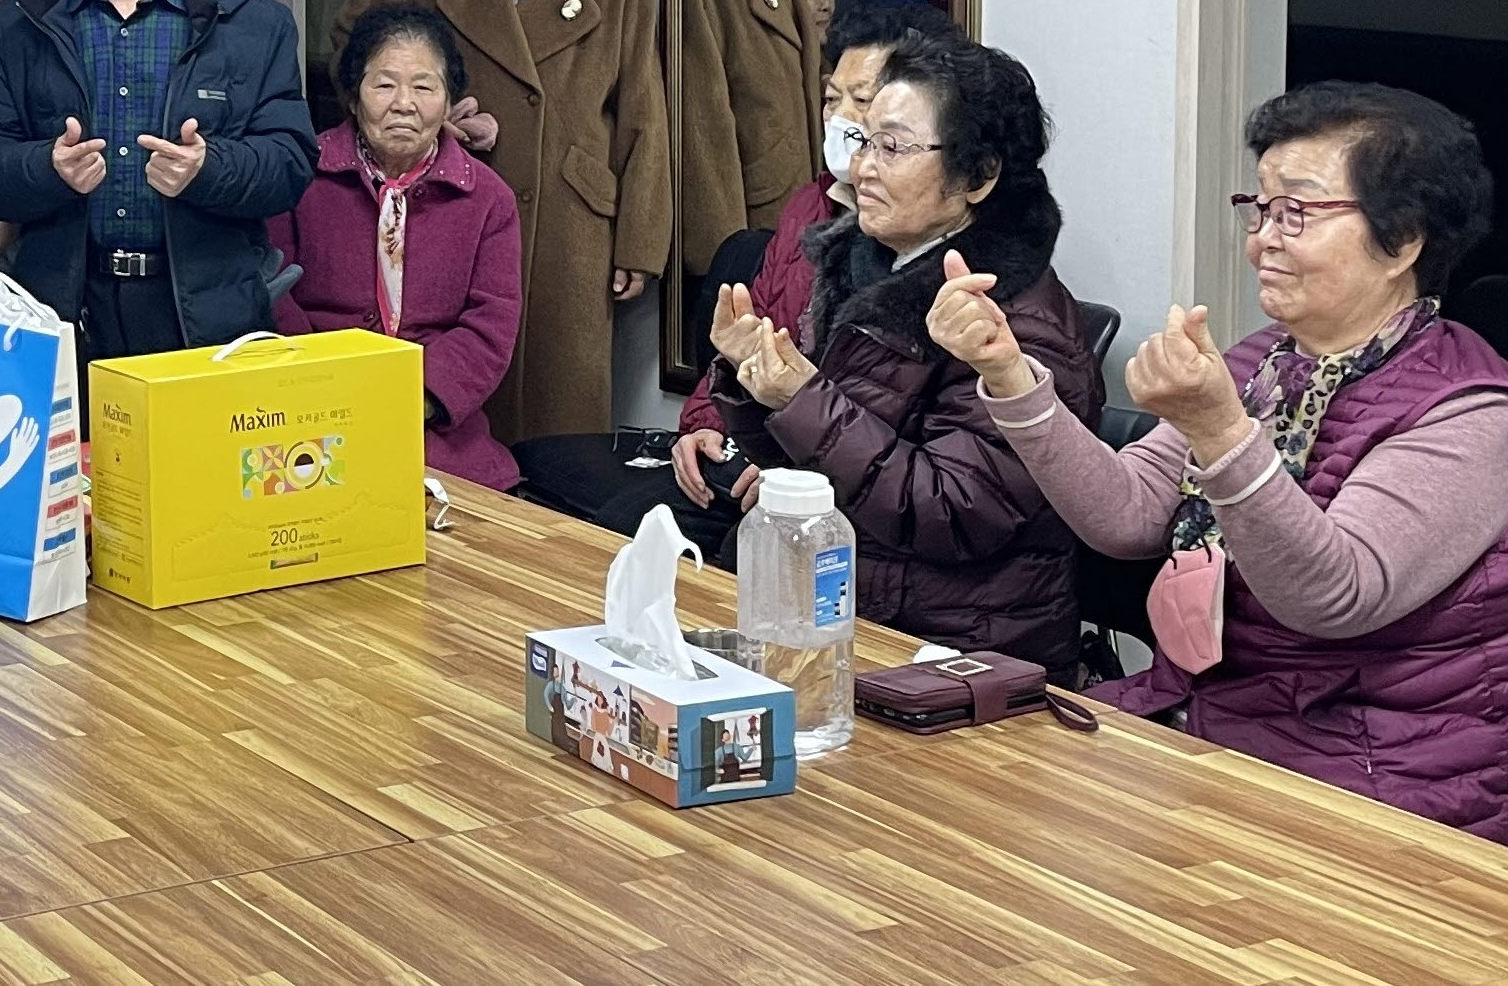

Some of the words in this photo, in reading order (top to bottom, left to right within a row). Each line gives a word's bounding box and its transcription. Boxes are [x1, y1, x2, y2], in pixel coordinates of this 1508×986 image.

[103, 403, 132, 426] Maxim
[230, 407, 286, 433] Maxim
[270, 527, 298, 546] 200
